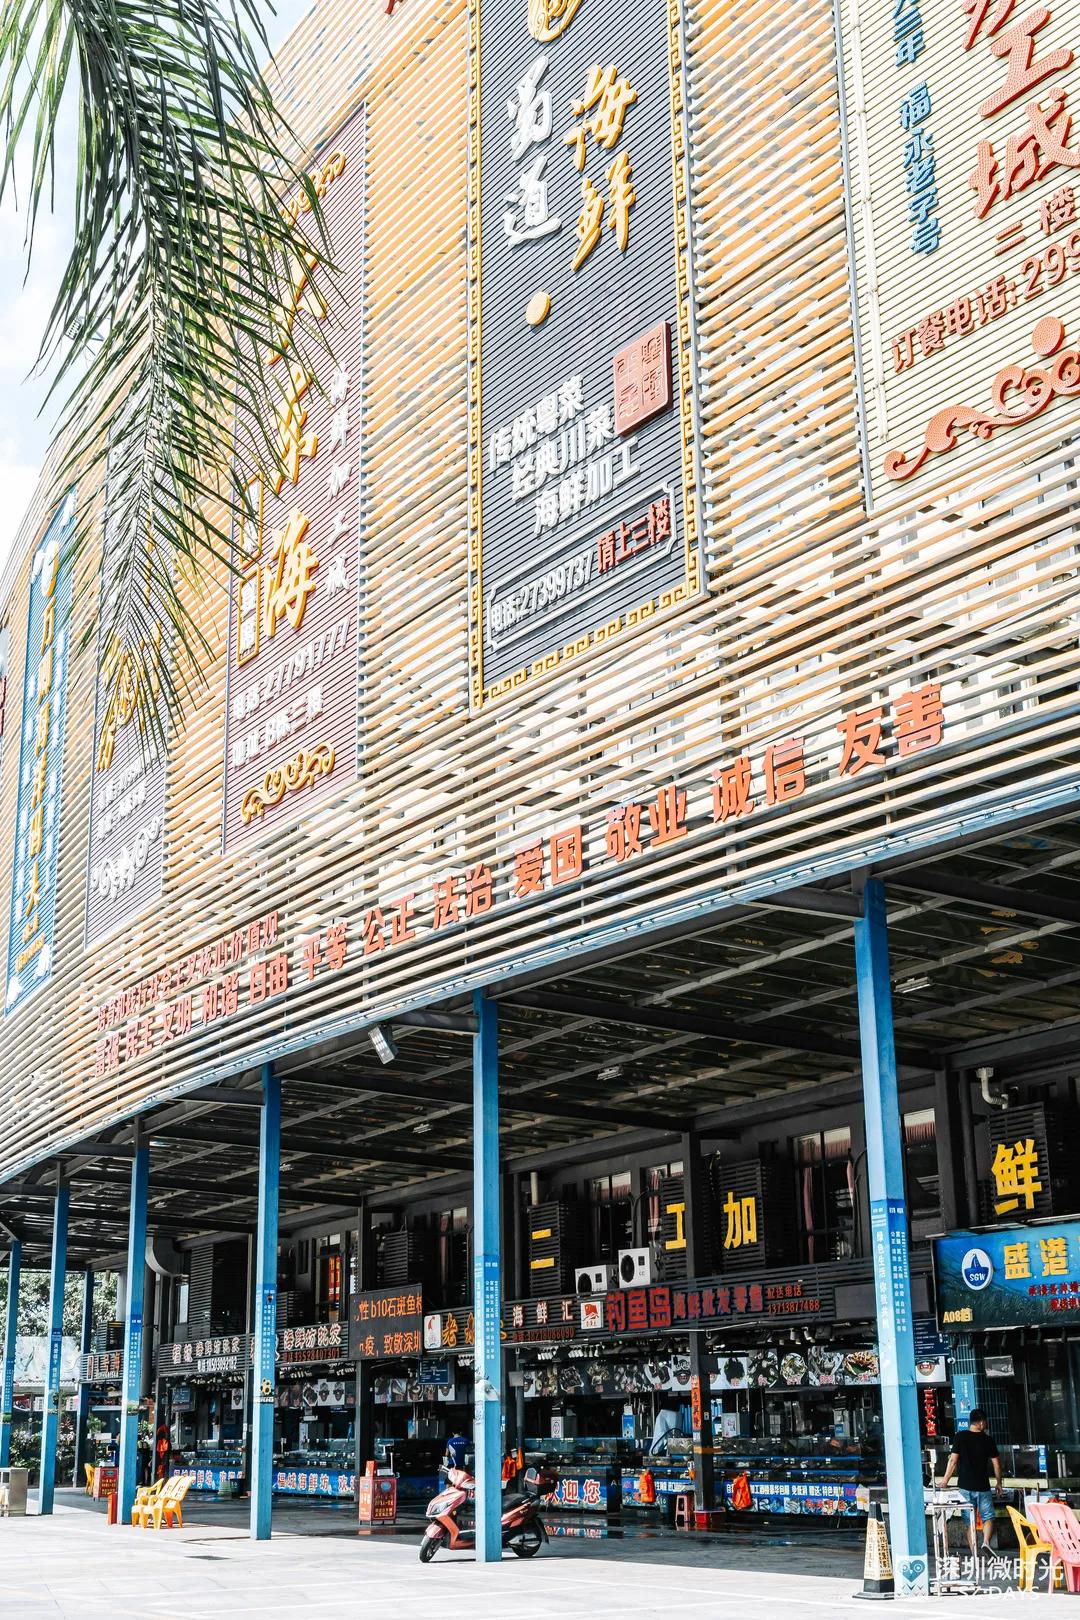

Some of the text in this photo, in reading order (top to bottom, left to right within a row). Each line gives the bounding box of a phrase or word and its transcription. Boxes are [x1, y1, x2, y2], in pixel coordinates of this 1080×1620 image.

[899, 80, 942, 256] 福永老字号
[994, 186, 1078, 258] 二楼
[488, 373, 585, 472] 传统粤菜
[511, 403, 615, 502] 经典川菜
[533, 435, 642, 535] 海鲜加工
[597, 497, 673, 573] 请上三楼
[125, 1015, 155, 1062] 民主
[160, 993, 193, 1046] 文明
[201, 971, 240, 1026] 和谐
[250, 952, 288, 1006] 自由
[300, 920, 348, 982] 平等
[362, 891, 417, 957] 公正
[432, 863, 493, 930] 法治
[513, 823, 584, 899] 爱国
[605, 785, 688, 863] 敬业
[711, 737, 807, 824] 诚信
[836, 683, 946, 777] 友善
[665, 1202, 687, 1250] 工
[723, 1191, 758, 1250] 加
[991, 1138, 1042, 1216] 鲜
[512, 1300, 575, 1328] 海鲜汇
[606, 1286, 671, 1332] 钓鱼岛
[766, 1282, 803, 1299] 配送电话
[969, 1272, 986, 1282] SGW
